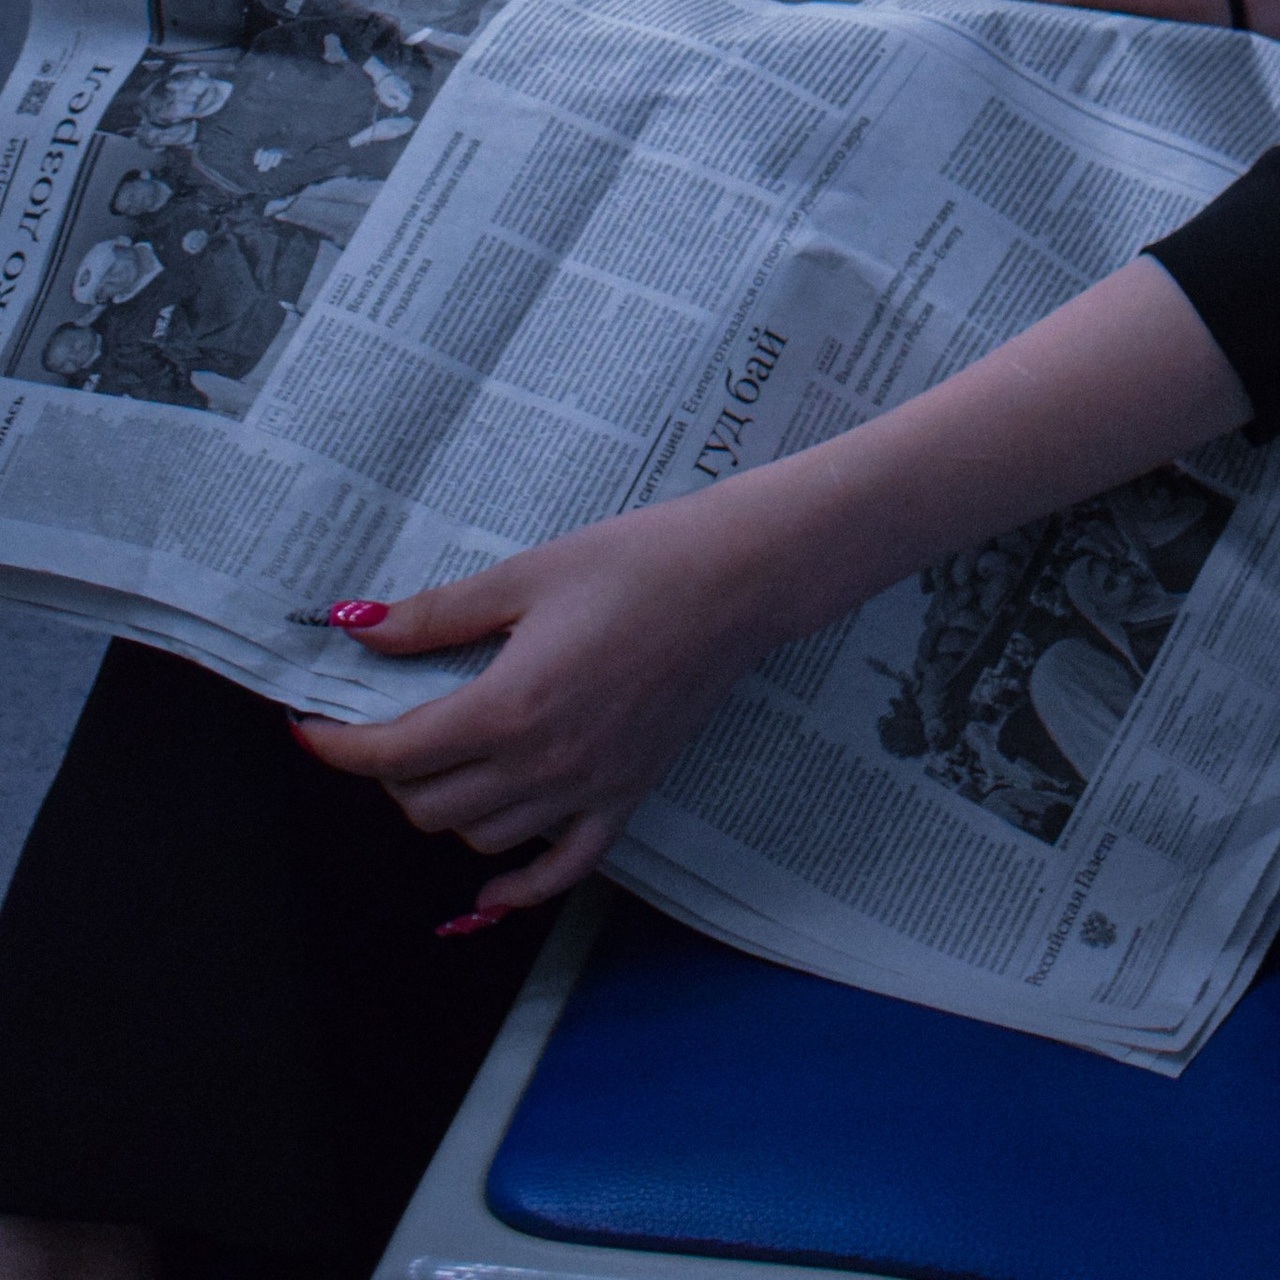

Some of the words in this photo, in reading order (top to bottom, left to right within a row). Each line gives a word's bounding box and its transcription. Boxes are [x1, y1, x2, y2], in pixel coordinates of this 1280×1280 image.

[0, 252, 27, 309] ко
[17, 64, 113, 242] дозрел
[345, 279, 375, 314] Всего
[366, 264, 384, 280] 25
[378, 203, 420, 264] процентов
[415, 131, 464, 203] сторонников
[367, 257, 410, 323] демпартии
[420, 177, 458, 226] Байдена
[452, 138, 482, 178] главой
[385, 258, 433, 329] государства
[680, 362, 718, 415] Египет
[712, 288, 758, 364] отказался
[761, 210, 804, 275] покупки
[638, 421, 688, 503] СИТУАЦИЕЙ
[693, 408, 753, 480] гуд
[725, 327, 788, 405] бай
[1025, 888, 1088, 986] Российская
[1074, 832, 1119, 889] Газета
